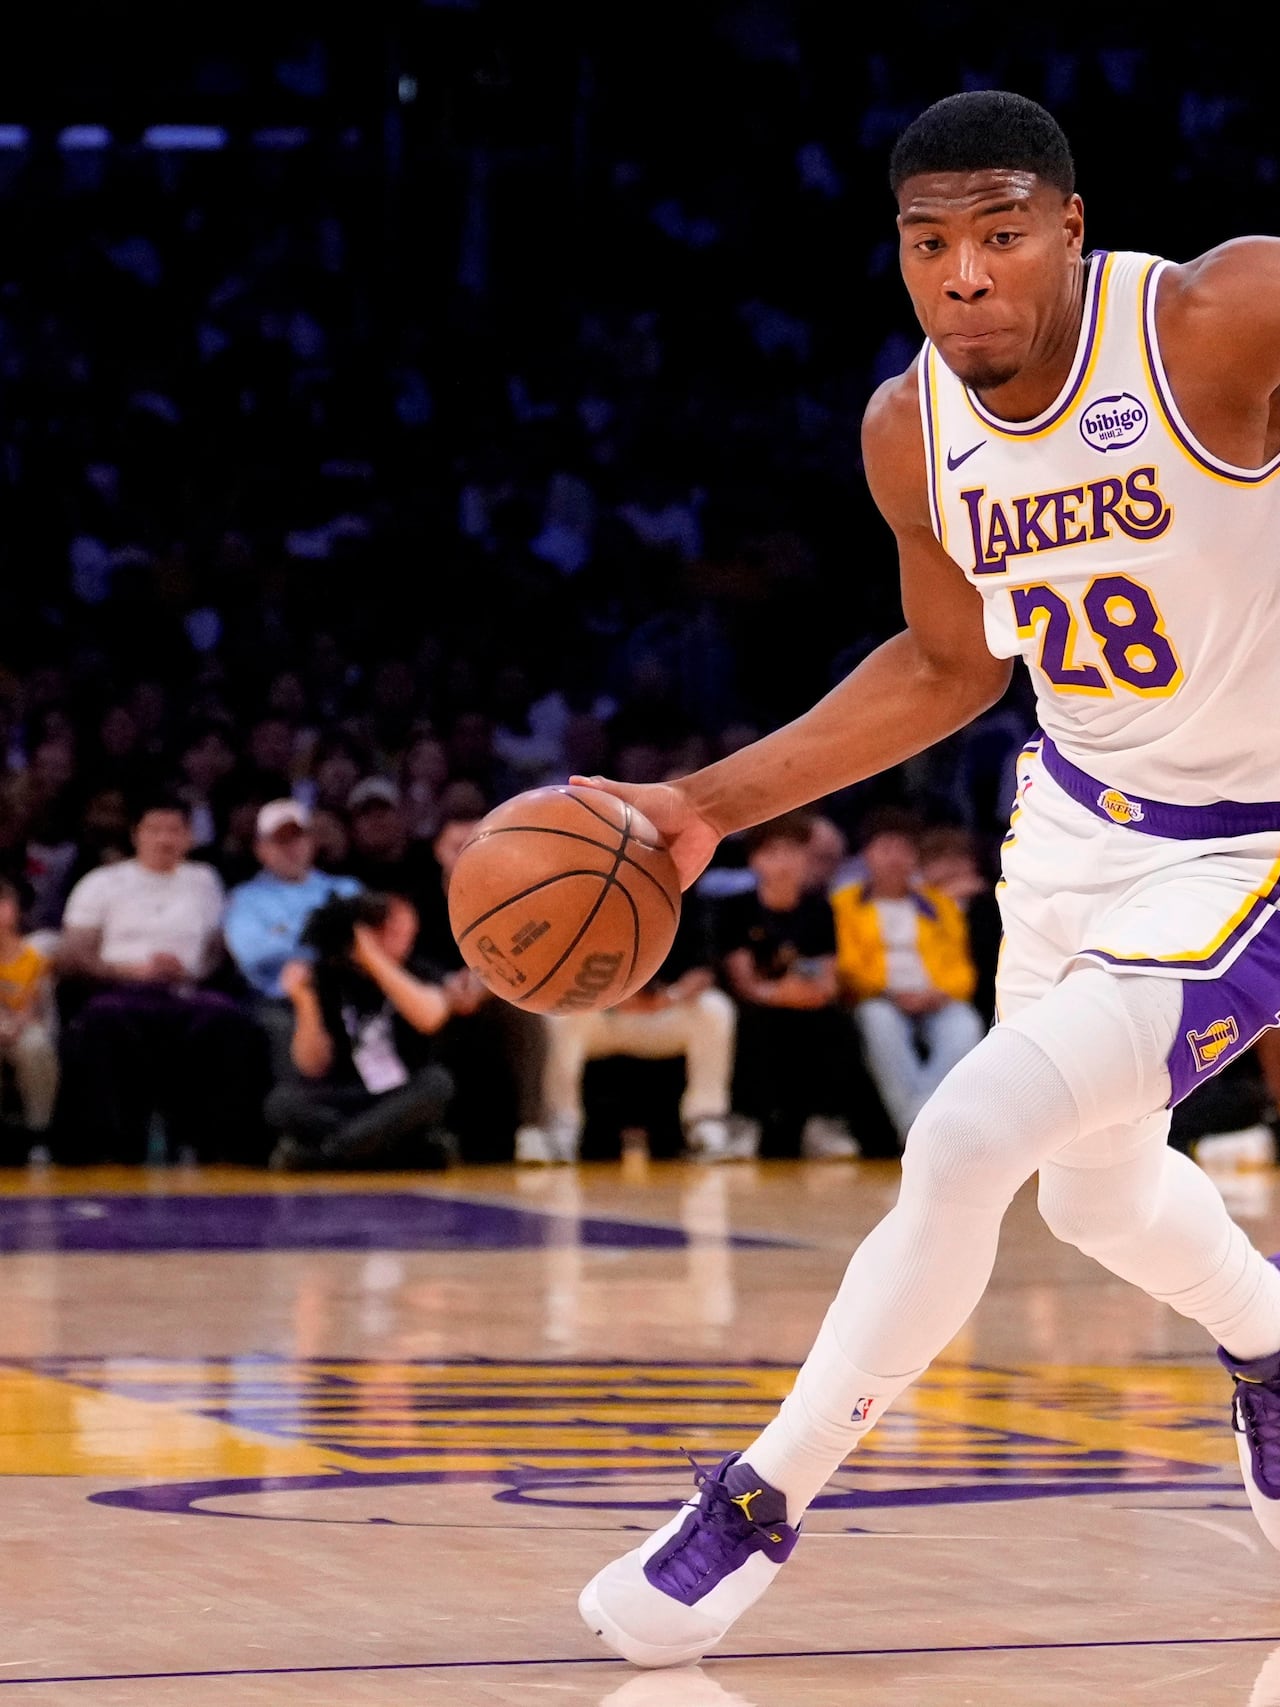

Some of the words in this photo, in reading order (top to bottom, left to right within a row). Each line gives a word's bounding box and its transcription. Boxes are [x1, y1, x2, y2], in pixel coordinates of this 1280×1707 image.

[1085, 408, 1143, 434] bibigo
[1098, 427, 1124, 441] 비비고
[960, 465, 1175, 577] LAKERS
[1008, 571, 1185, 700] 28
[1100, 794, 1144, 821] LAKERS
